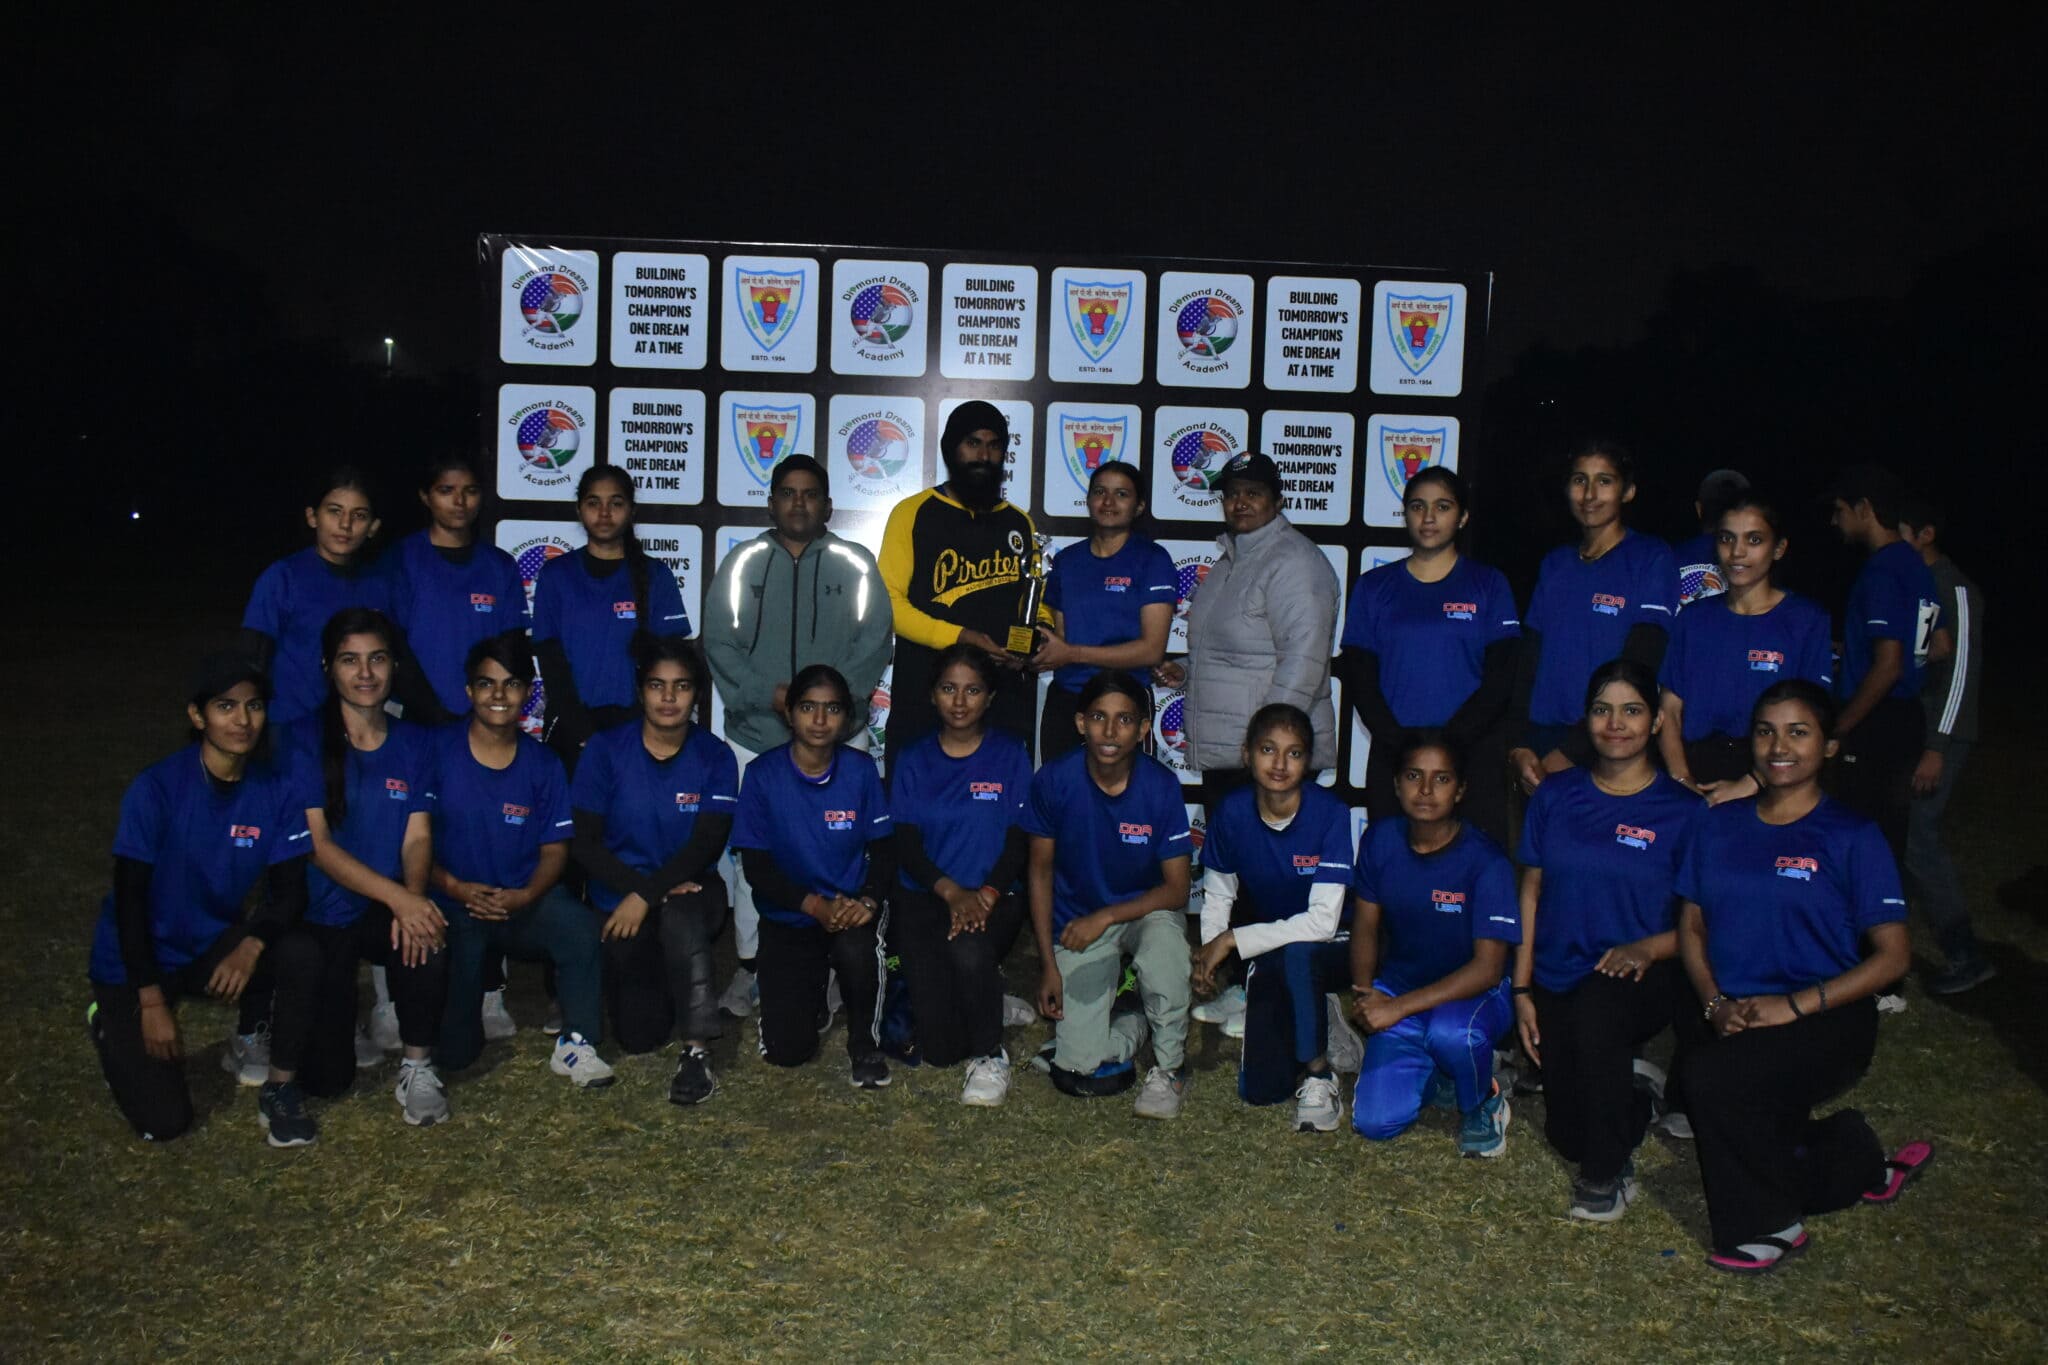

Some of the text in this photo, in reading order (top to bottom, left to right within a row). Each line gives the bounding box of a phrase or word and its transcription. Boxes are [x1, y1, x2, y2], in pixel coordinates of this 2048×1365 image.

[559, 265, 589, 292] Dreams
[635, 267, 686, 281] BUILDING
[624, 285, 697, 300] TOMORROW'S
[889, 276, 919, 303] Dreams
[965, 279, 1015, 292] BUILDING
[954, 296, 1026, 311] TOMORROW'S
[1214, 288, 1244, 316] Dreams
[1289, 291, 1338, 305] BUILDING
[628, 304, 691, 318] CHAMPIONS
[1278, 309, 1348, 324] TOMORROW'S
[630, 322, 689, 336] ONE DREAM
[957, 315, 1021, 329] CHAMPIONS
[959, 333, 1018, 348] ONE DREAM
[1281, 327, 1343, 342] CHAMPIONS
[527, 337, 575, 350] Academy
[634, 341, 683, 354] AT A TIME
[857, 348, 905, 361] Academy
[964, 351, 1012, 366] AT A TIME
[1282, 345, 1340, 360] ONE DREAM
[1182, 360, 1229, 373] Academy
[1287, 364, 1334, 378] AT A TIME
[555, 400, 586, 427] Dreams
[632, 402, 682, 417] BUILDING
[621, 420, 693, 435] TOMORROW'S
[885, 411, 916, 438] Dreams
[1209, 422, 1239, 450] Dreams
[1284, 425, 1332, 439] BUILDING
[625, 439, 688, 453] CHAMPIONS
[1272, 442, 1342, 457] TOMORROW'S
[626, 457, 686, 472] ONE DREAM
[1277, 461, 1337, 475] CHAMPIONS
[523, 473, 571, 486] Academy
[645, 476, 653, 489] A
[655, 476, 680, 490] TIME
[1300, 480, 1334, 493] DREAM
[1282, 497, 1328, 511] AT A TIME
[933, 548, 1020, 593] Pirates
